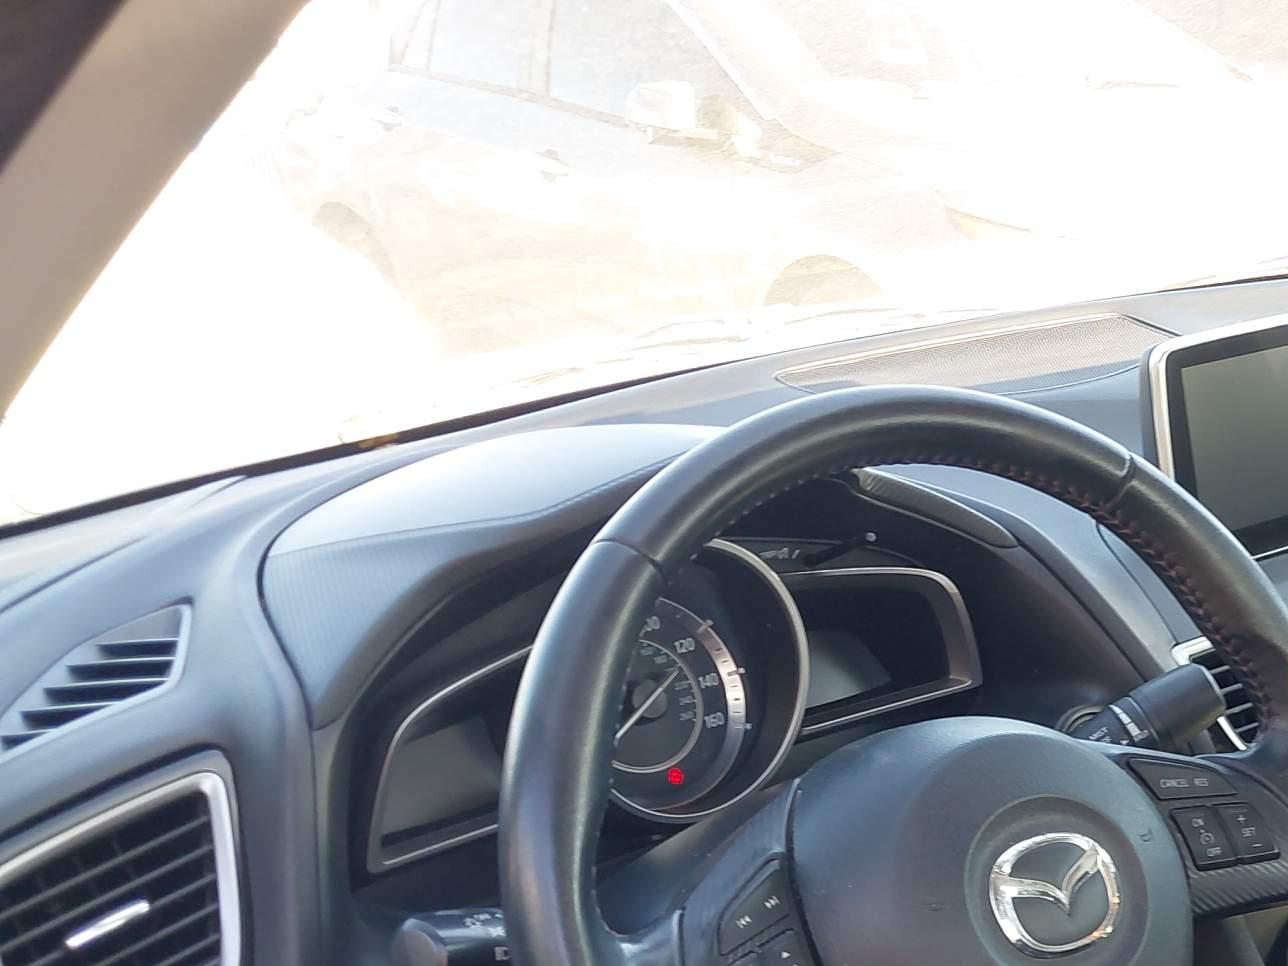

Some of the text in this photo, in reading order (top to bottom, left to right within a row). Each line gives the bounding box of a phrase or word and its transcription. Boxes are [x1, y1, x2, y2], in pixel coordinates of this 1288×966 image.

[674, 638, 695, 653] 120
[698, 673, 719, 688] 140
[704, 712, 724, 728] 160
